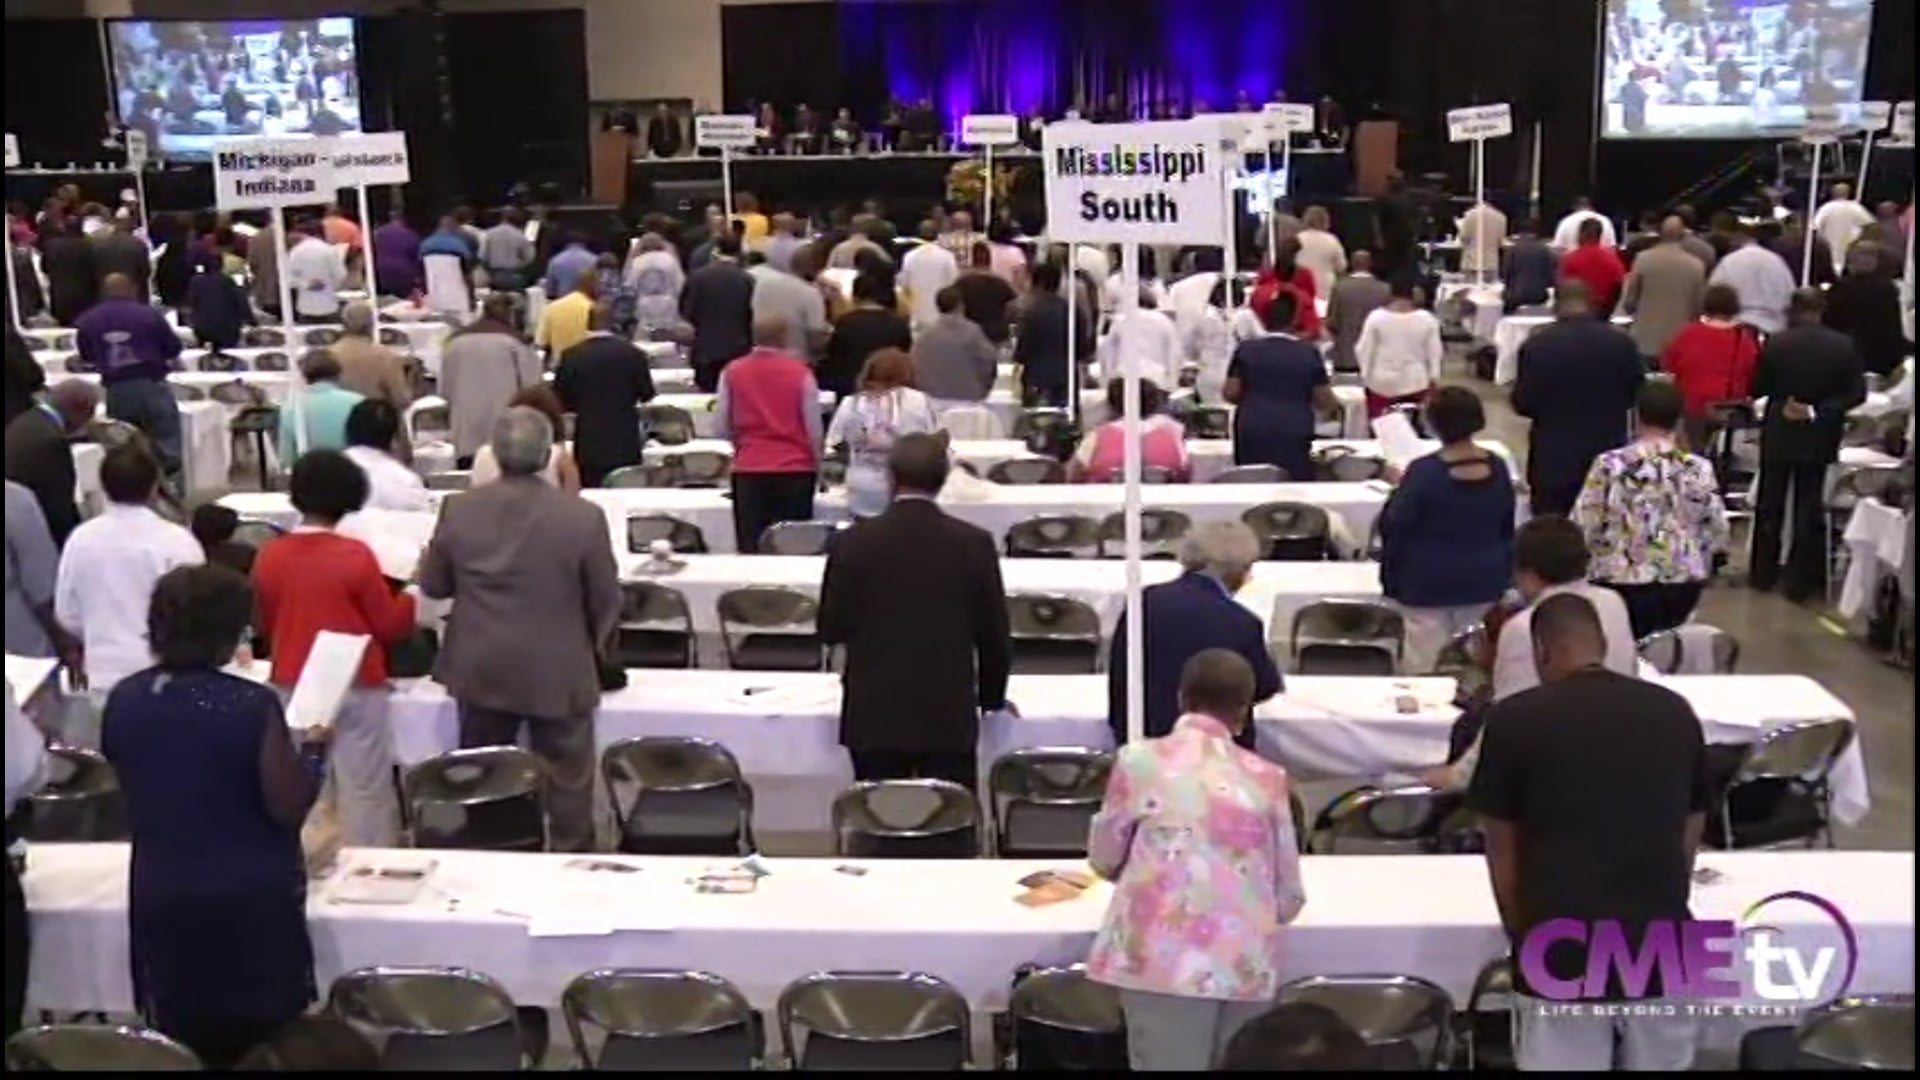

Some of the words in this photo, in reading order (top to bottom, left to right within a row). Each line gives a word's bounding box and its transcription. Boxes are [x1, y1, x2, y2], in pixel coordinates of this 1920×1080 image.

[219, 152, 316, 172] Michigan
[1057, 144, 1206, 182] Mississippi
[236, 176, 316, 196] Indiana
[1080, 191, 1178, 222] South
